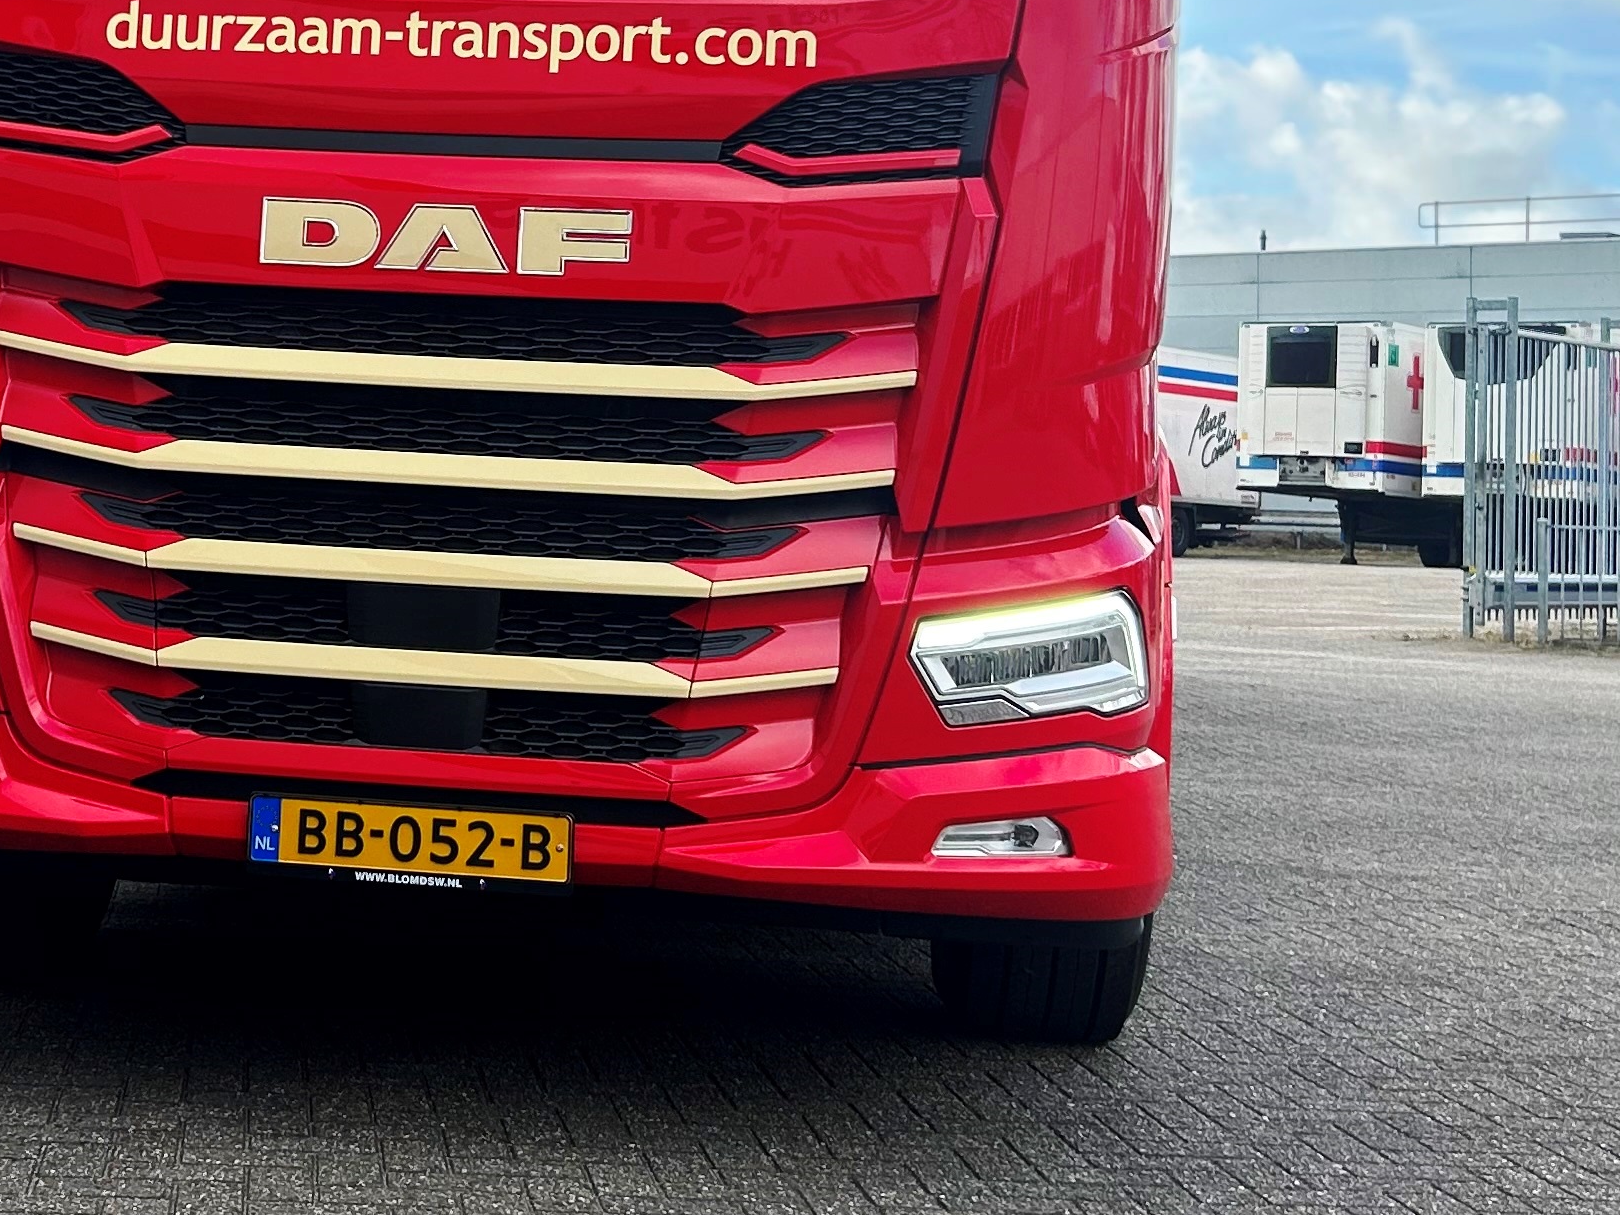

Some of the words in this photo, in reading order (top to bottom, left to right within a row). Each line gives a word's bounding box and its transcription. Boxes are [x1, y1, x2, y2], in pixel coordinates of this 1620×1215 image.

[105, 0, 818, 73] duurzaam-transport.com
[259, 196, 633, 276] DAF
[254, 835, 276, 851] NL
[297, 808, 552, 872] BB-052-B
[355, 871, 463, 889] WWW.BLOMDSW.NL
